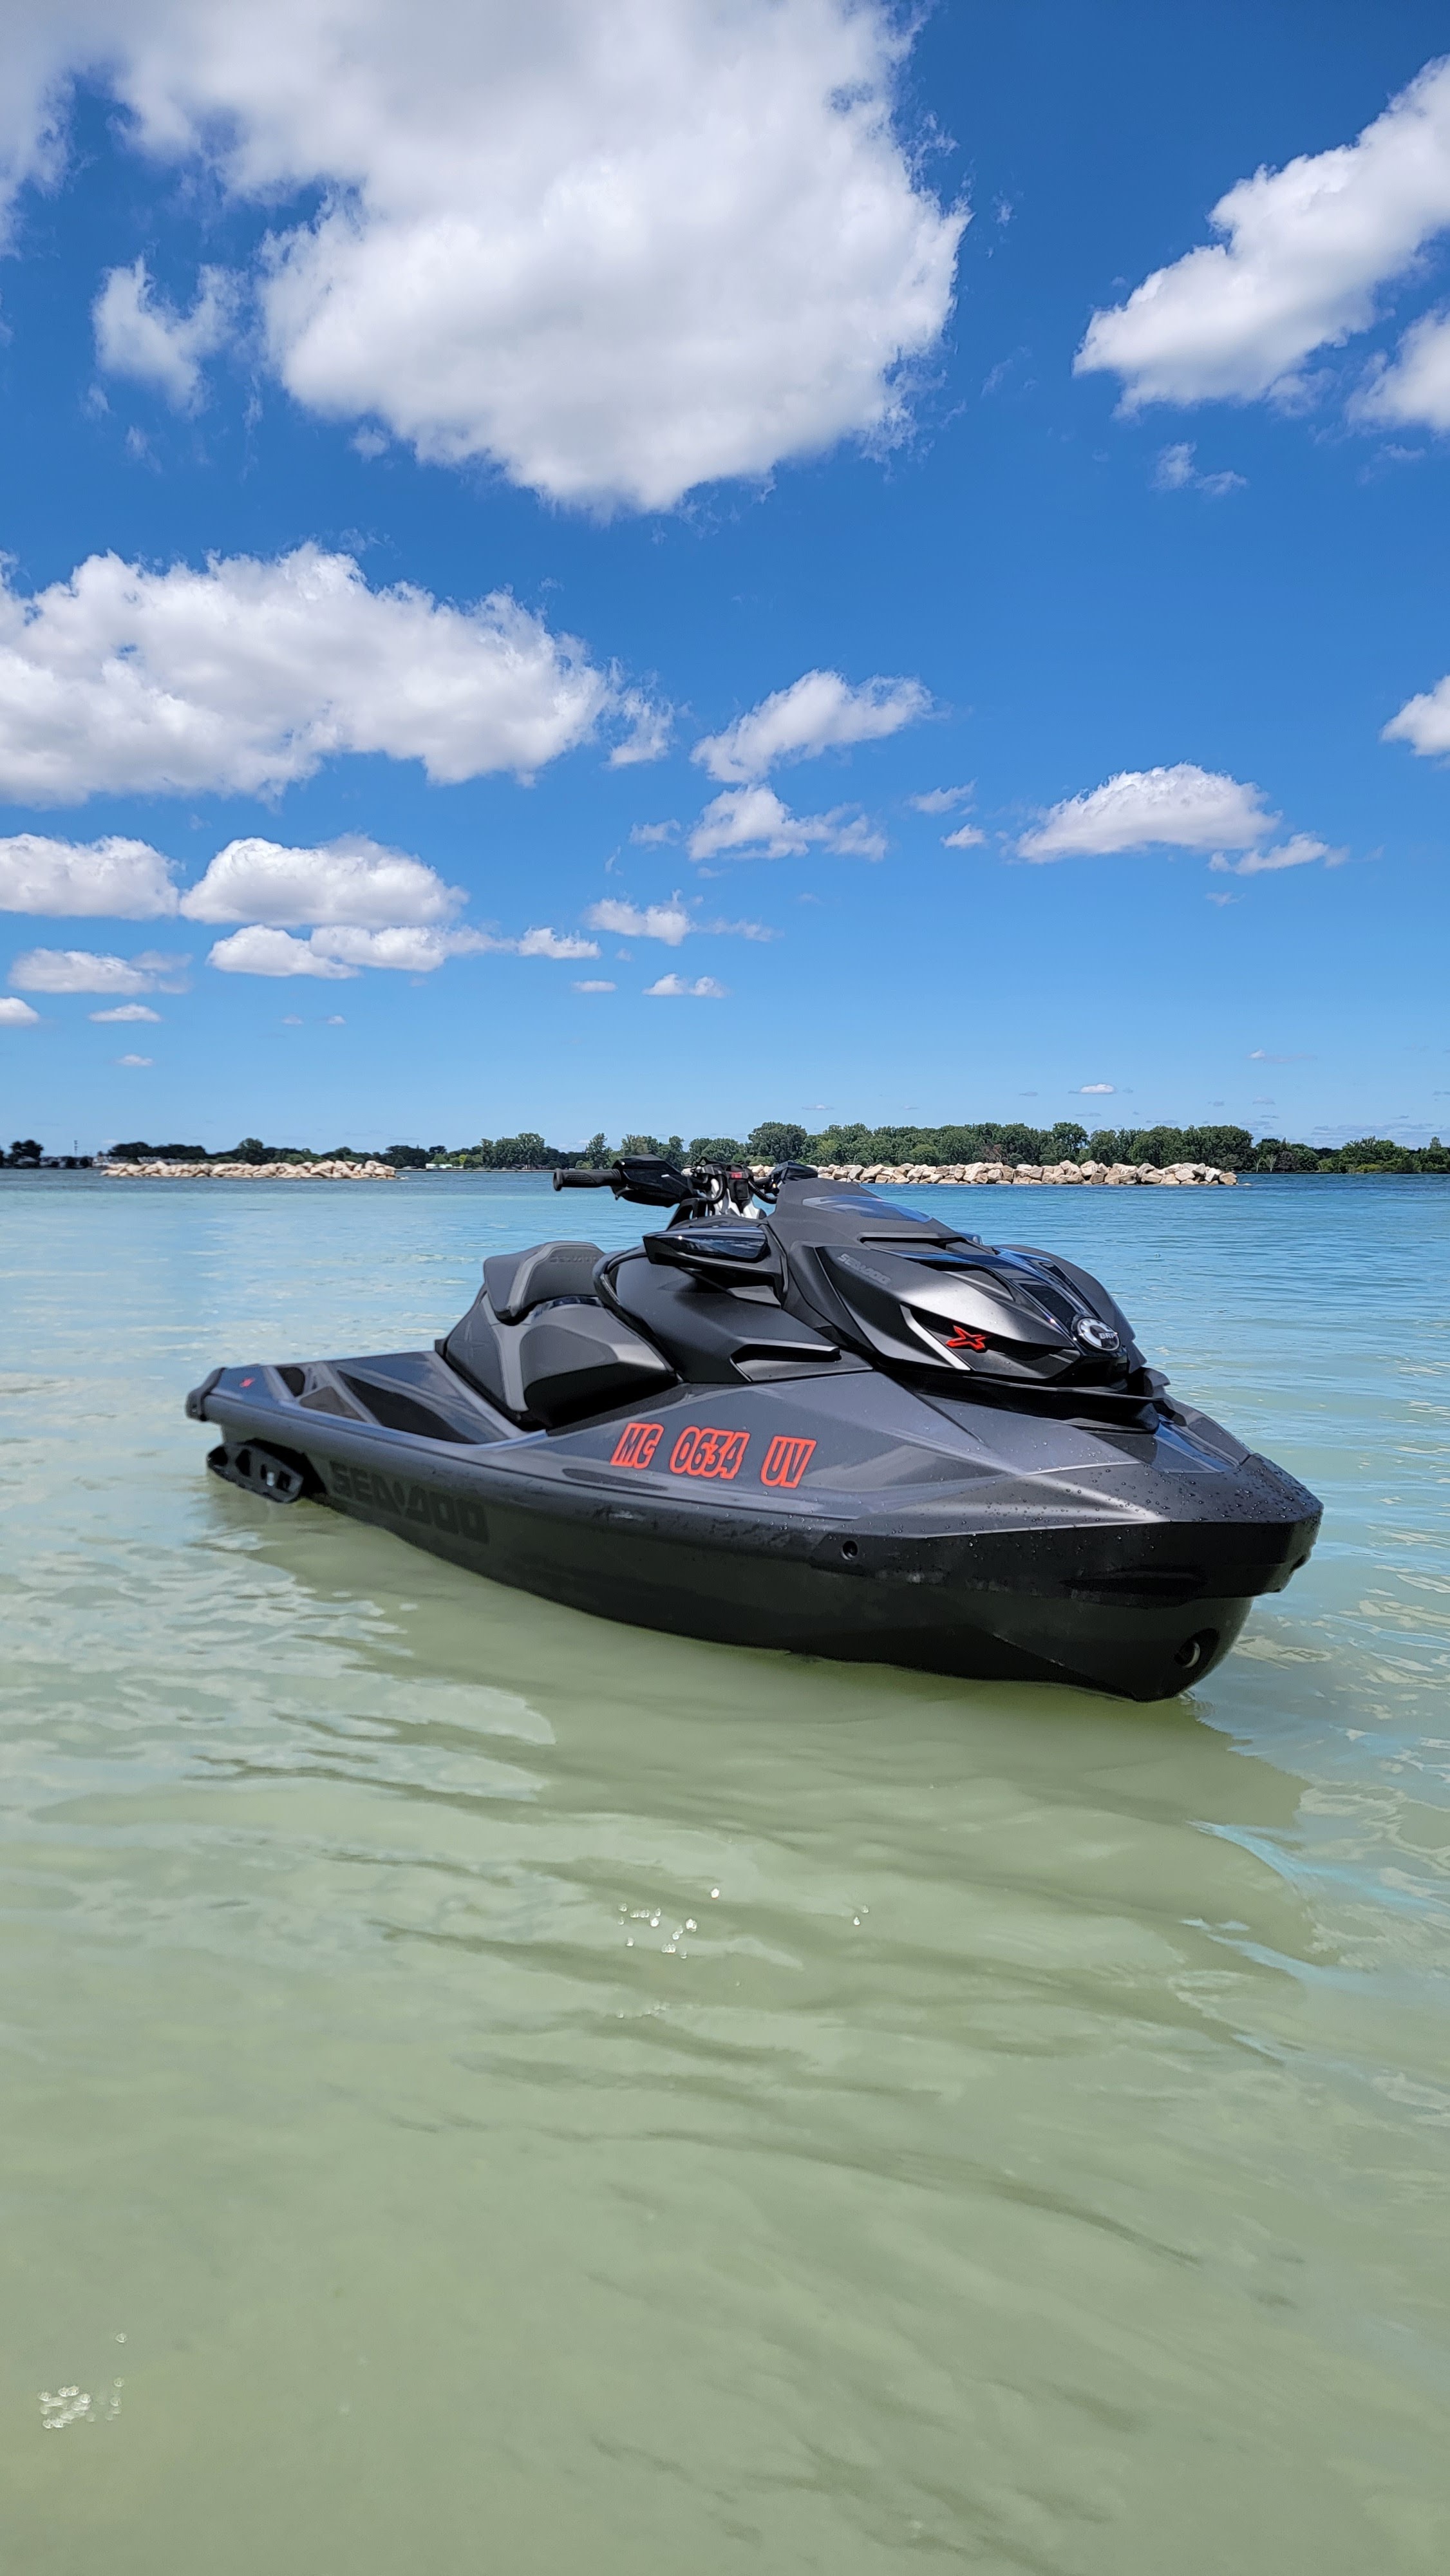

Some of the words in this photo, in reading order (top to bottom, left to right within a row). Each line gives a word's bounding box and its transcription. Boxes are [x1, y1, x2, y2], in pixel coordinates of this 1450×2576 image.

[609, 1422, 664, 1470] MC
[668, 1425, 751, 1480] 0634
[760, 1435, 817, 1489] UV
